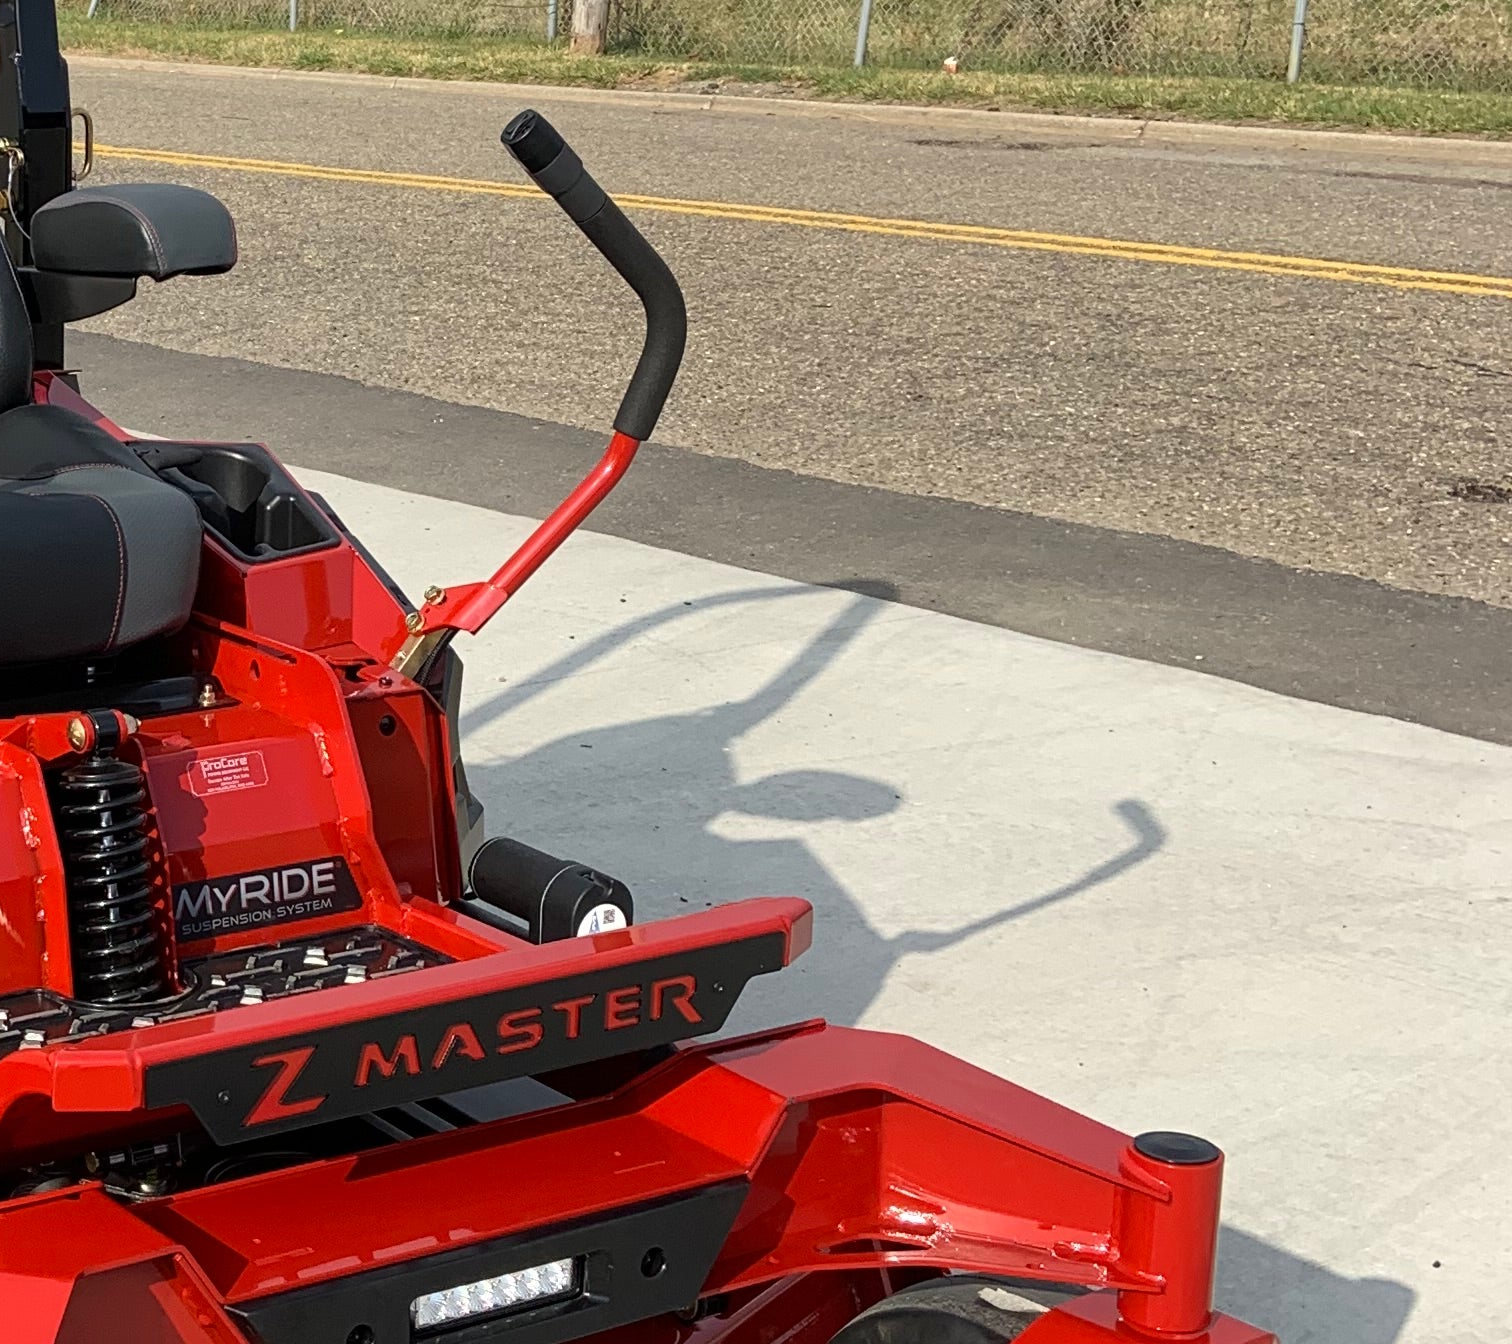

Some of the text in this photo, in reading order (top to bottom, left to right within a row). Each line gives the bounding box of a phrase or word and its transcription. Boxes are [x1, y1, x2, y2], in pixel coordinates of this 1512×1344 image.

[181, 898, 333, 935] SUSPENSION SYSTEM
[241, 974, 704, 1127] Z MASTER
